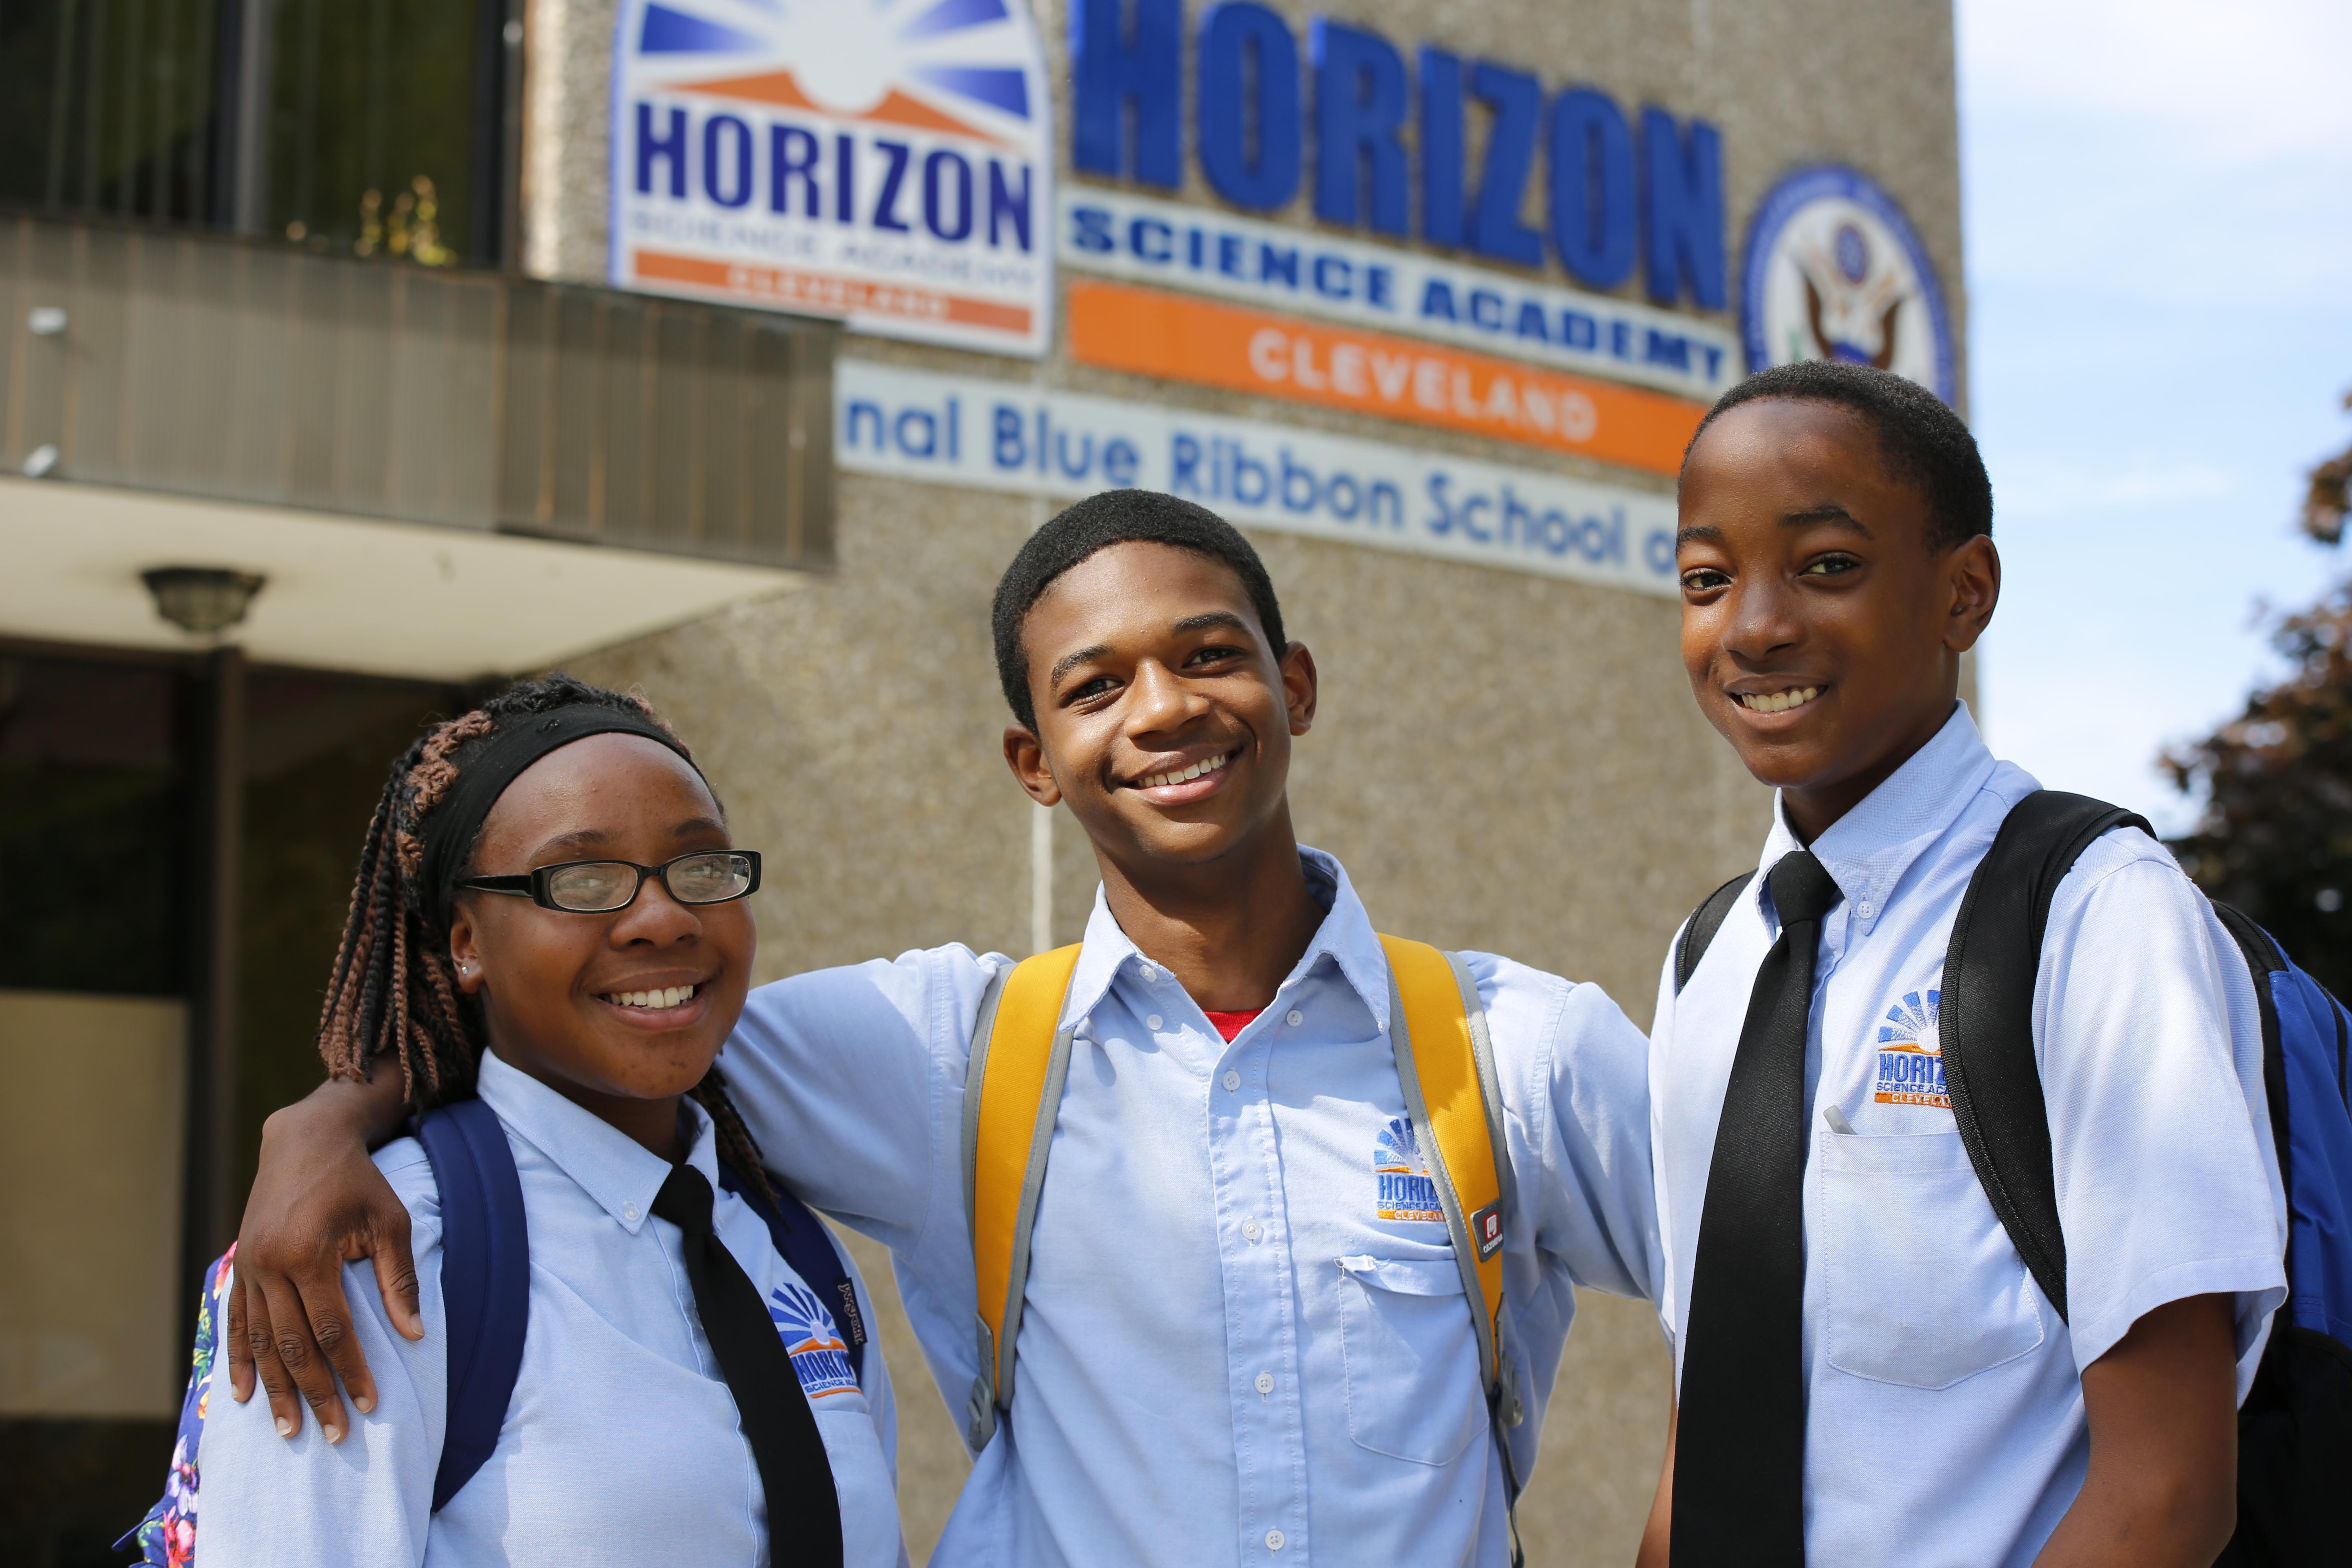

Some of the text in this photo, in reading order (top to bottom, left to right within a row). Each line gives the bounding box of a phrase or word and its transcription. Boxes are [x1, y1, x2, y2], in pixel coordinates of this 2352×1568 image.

[635, 100, 1031, 253] HORIZON
[1069, 0, 1728, 310] HORIZON
[1072, 206, 1725, 381] SCIENCE ACADEMY
[1248, 327, 1599, 443] CLEVELAND
[847, 395, 960, 462] nal
[992, 404, 1141, 486] Blue
[1170, 430, 1403, 532] Ribbon
[1424, 468, 1628, 566] School
[1876, 1082, 1924, 1092] SCIENCE
[1377, 1201, 1421, 1210] SCIENCE
[804, 1379, 846, 1393] SCIENCE
